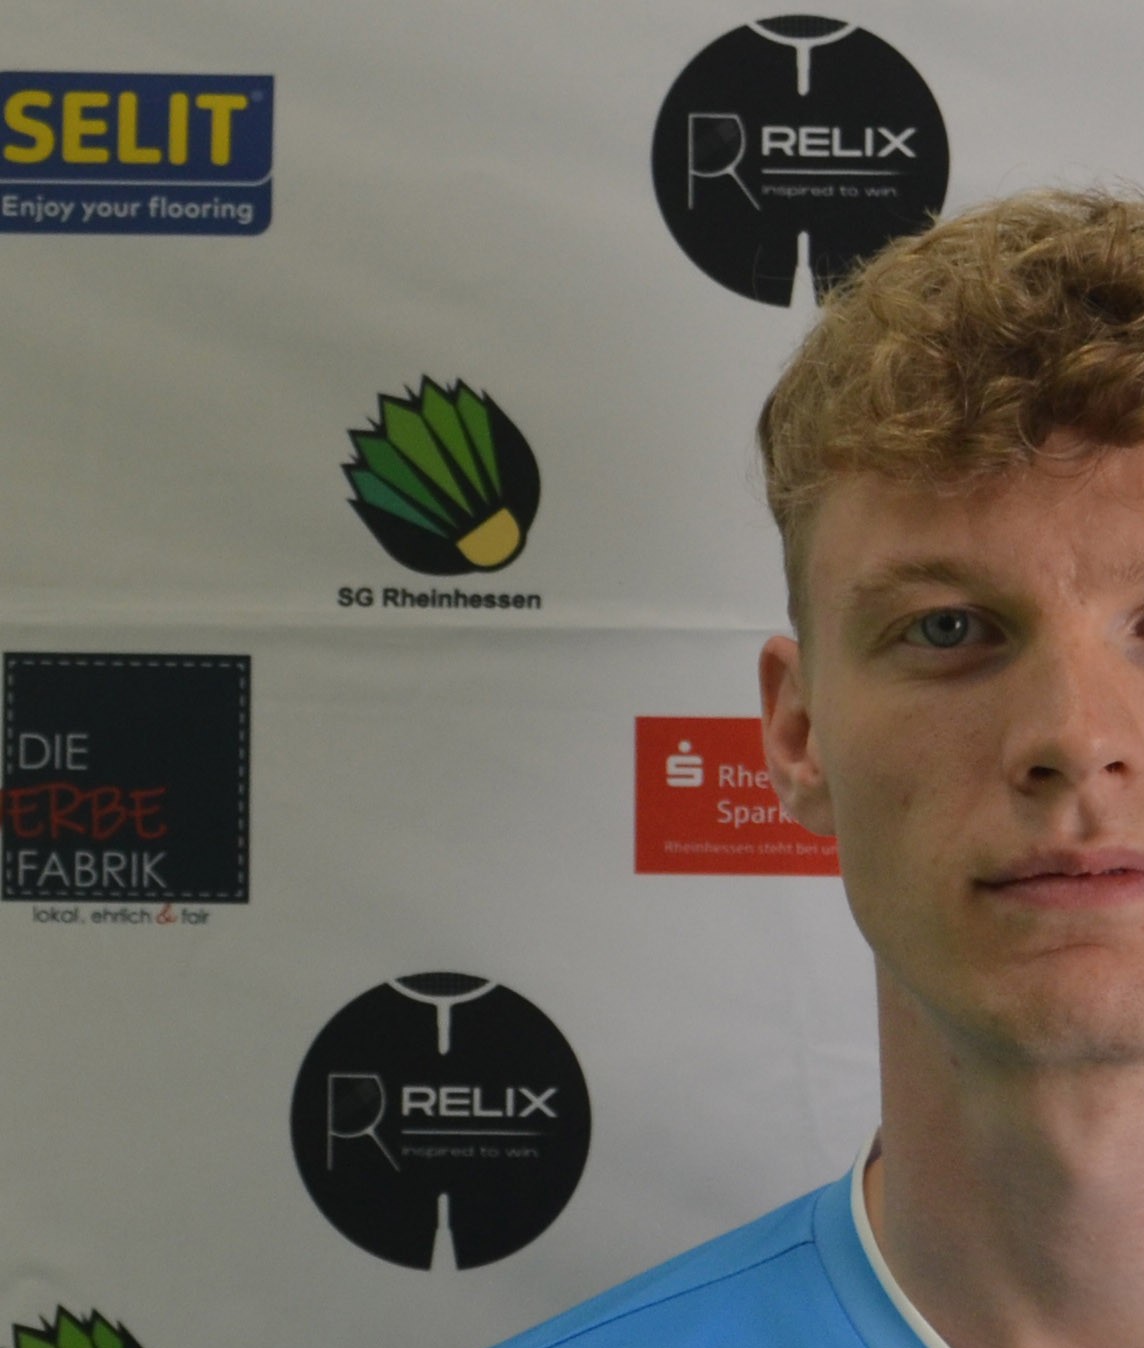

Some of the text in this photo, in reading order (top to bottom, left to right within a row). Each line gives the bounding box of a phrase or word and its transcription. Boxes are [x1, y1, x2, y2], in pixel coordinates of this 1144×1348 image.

[4, 90, 248, 167] SELIT
[761, 126, 917, 158] RELIX
[761, 184, 897, 198] inspired to win
[2, 195, 254, 225] Enjoy your flooring
[337, 587, 542, 609] SG Rheinhessen
[18, 733, 89, 771] DIE
[718, 764, 773, 789] Rhe
[0, 782, 168, 840] ERBE
[717, 800, 799, 830] Spark
[17, 851, 168, 889] FABRIK
[91, 909, 150, 925] ehrlich
[156, 901, 178, 925] &
[181, 908, 211, 925] fair
[402, 1086, 558, 1119] RELIX
[480, 1146, 500, 1158] to
